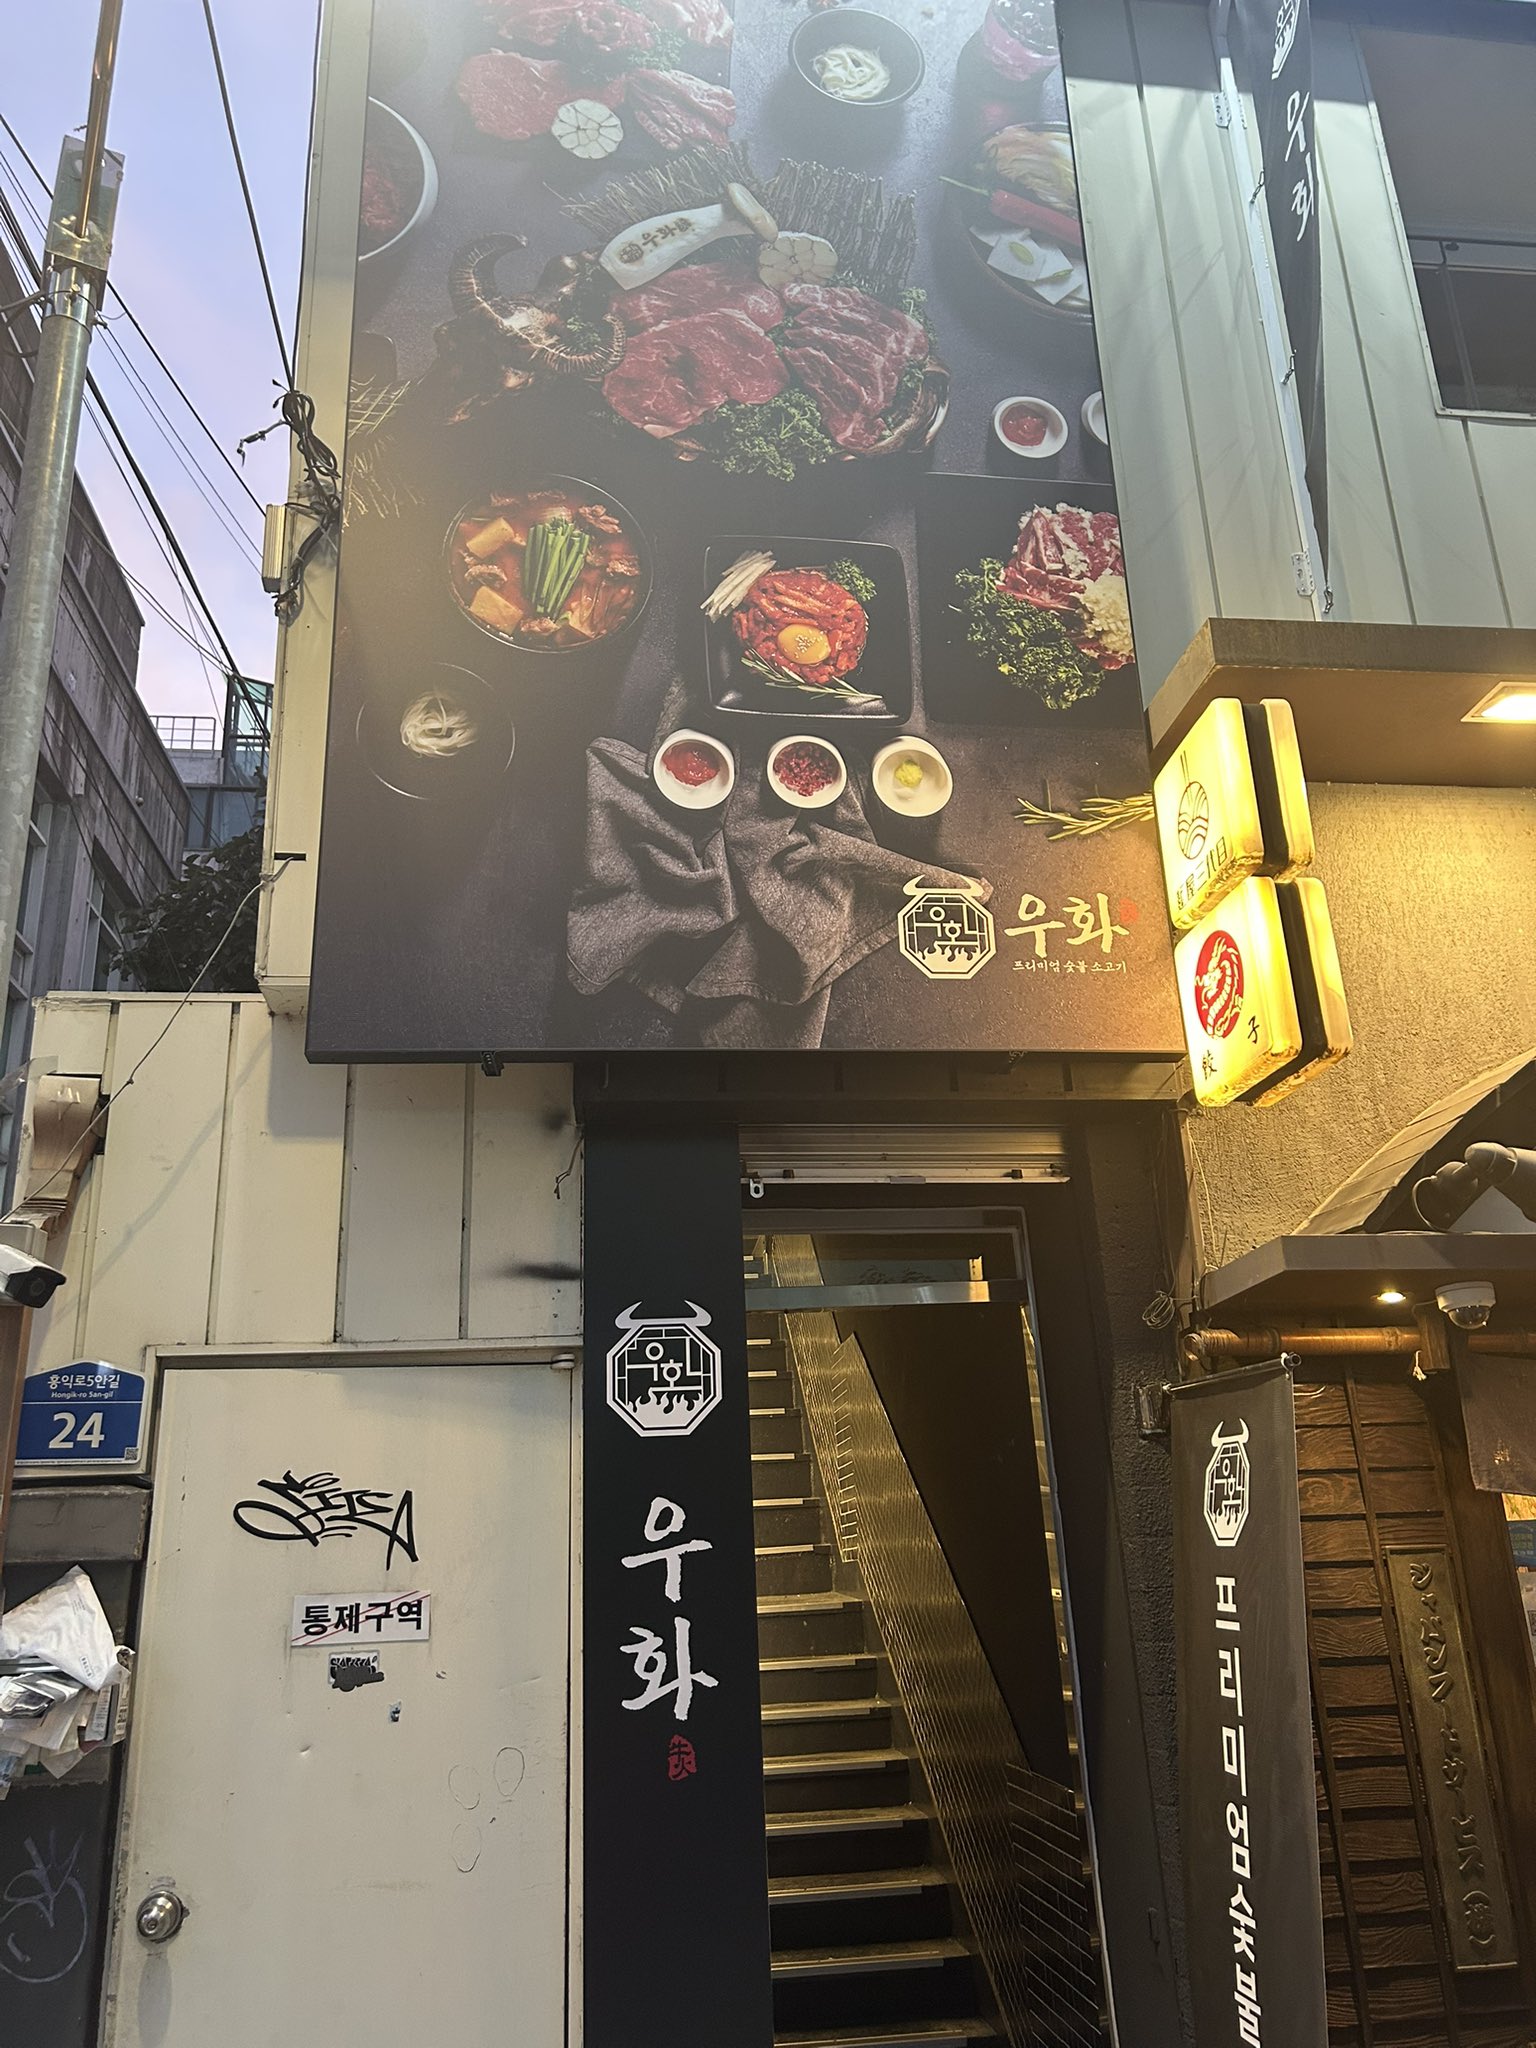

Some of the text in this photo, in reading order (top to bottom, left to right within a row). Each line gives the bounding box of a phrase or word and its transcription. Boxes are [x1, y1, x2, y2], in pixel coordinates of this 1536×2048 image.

[642, 224, 677, 247] 우화
[1004, 893, 1130, 958] 우화
[1012, 959, 1127, 974] 프리미엄 숯불 소고기
[48, 1374, 121, 1389] 홍익로5안길
[51, 1391, 87, 1400] Hongik-ro
[48, 1412, 105, 1449] 24
[301, 1599, 423, 1636] 통제구역
[621, 1496, 719, 1721] 우화
